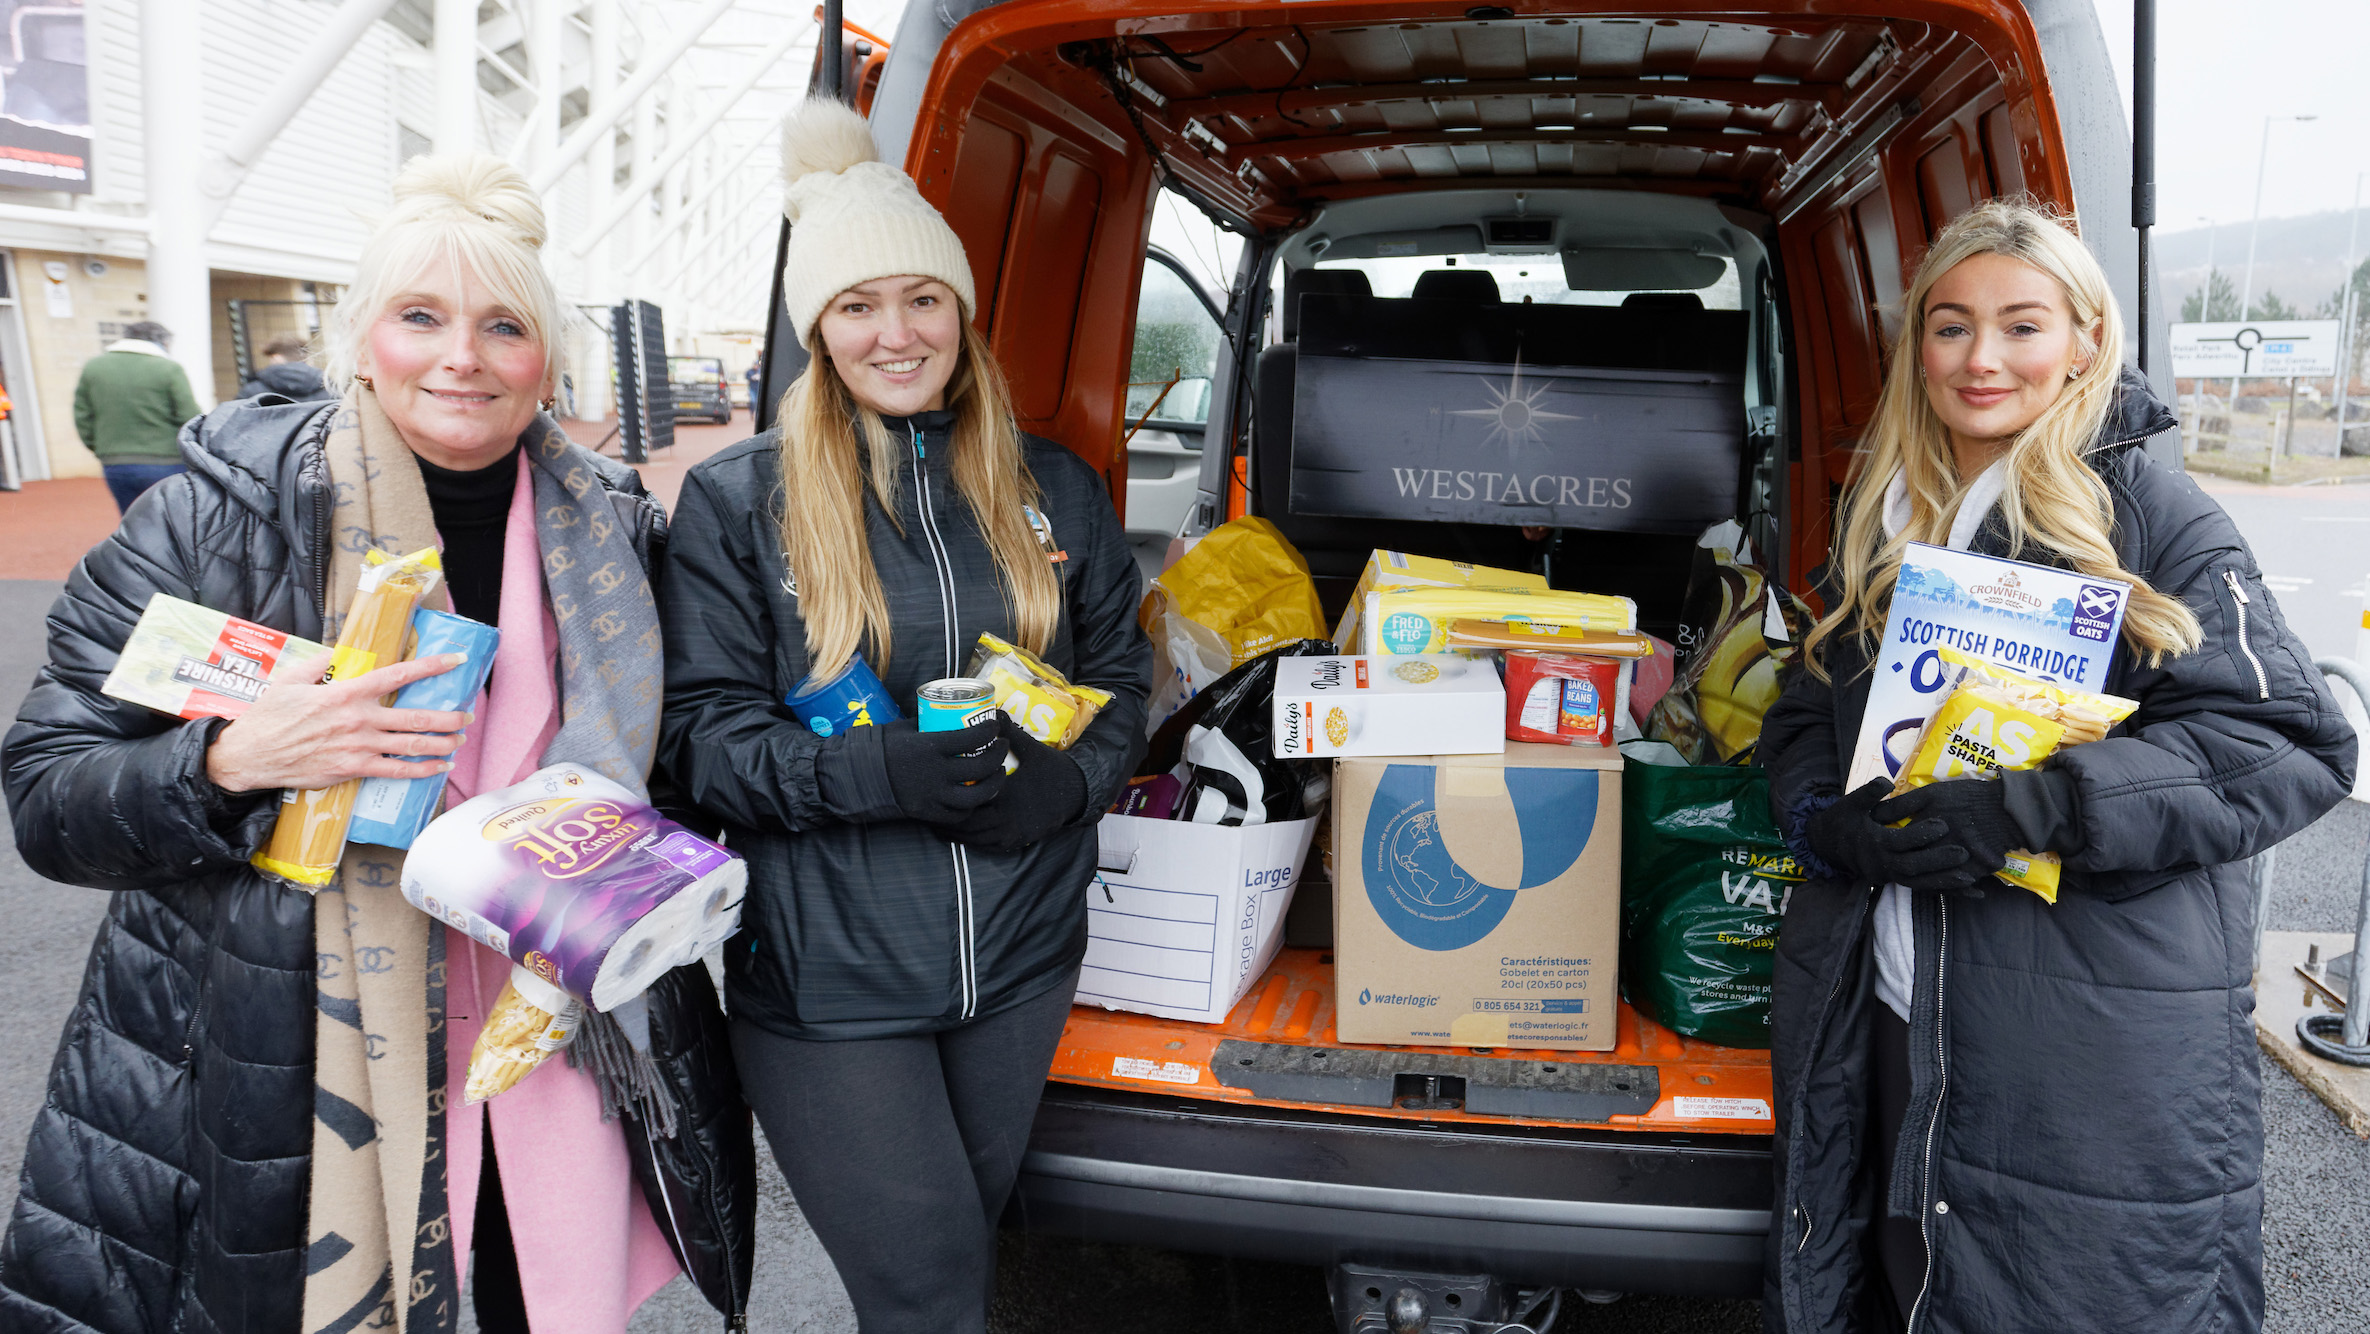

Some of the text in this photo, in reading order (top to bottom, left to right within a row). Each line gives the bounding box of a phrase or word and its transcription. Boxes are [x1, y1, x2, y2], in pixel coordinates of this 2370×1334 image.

[1392, 467, 1632, 510] WESTACRES
[1970, 584, 2042, 608] CROWNFIELD
[1392, 615, 1423, 630] FRED
[2074, 616, 2110, 630] SCOTTISH
[1258, 634, 1274, 646] Aldi
[2076, 626, 2103, 640] OATS
[1900, 618, 1988, 654] SCOTTISH
[1992, 641, 2089, 684] PORRIDGE
[222, 654, 260, 678] TEA
[1311, 660, 1346, 690] Daily's
[178, 659, 270, 698] ORKSHIRE
[1568, 679, 1593, 692] BAKED
[1567, 692, 1592, 704] BEANS
[969, 705, 998, 728] HEIN
[1284, 702, 1302, 754] Daily's
[1952, 734, 1996, 760] PASTA
[1948, 746, 2004, 772] SHAPES
[568, 776, 579, 786] 4
[1124, 788, 1141, 816] Bourbo
[498, 806, 546, 830] Quilted
[578, 823, 640, 856] Luxury
[1377, 799, 1424, 872] Provenant de sources durables
[1722, 850, 1805, 876] REMAR
[1246, 866, 1291, 888] Large
[1743, 922, 1772, 936] M&S
[1234, 894, 1256, 999] torage Box
[1718, 932, 1774, 950] Everyday
[1500, 956, 1592, 968] Caractéristiques:
[1500, 968, 1541, 978] Gobelet
[1556, 968, 1590, 977] carton
[1501, 980, 1588, 990] 20cl (20x50 pcs)
[1688, 976, 1772, 994] We recycle waste pl
[1476, 1001, 1540, 1011] 0 805 654 321
[1701, 990, 1728, 1000] stores
[1730, 992, 1748, 1002] and
[1748, 994, 1768, 1003] turn
[1509, 1021, 1588, 1031] ets@waterlogic.fr
[1507, 1033, 1588, 1042] etsecoresponsables/
